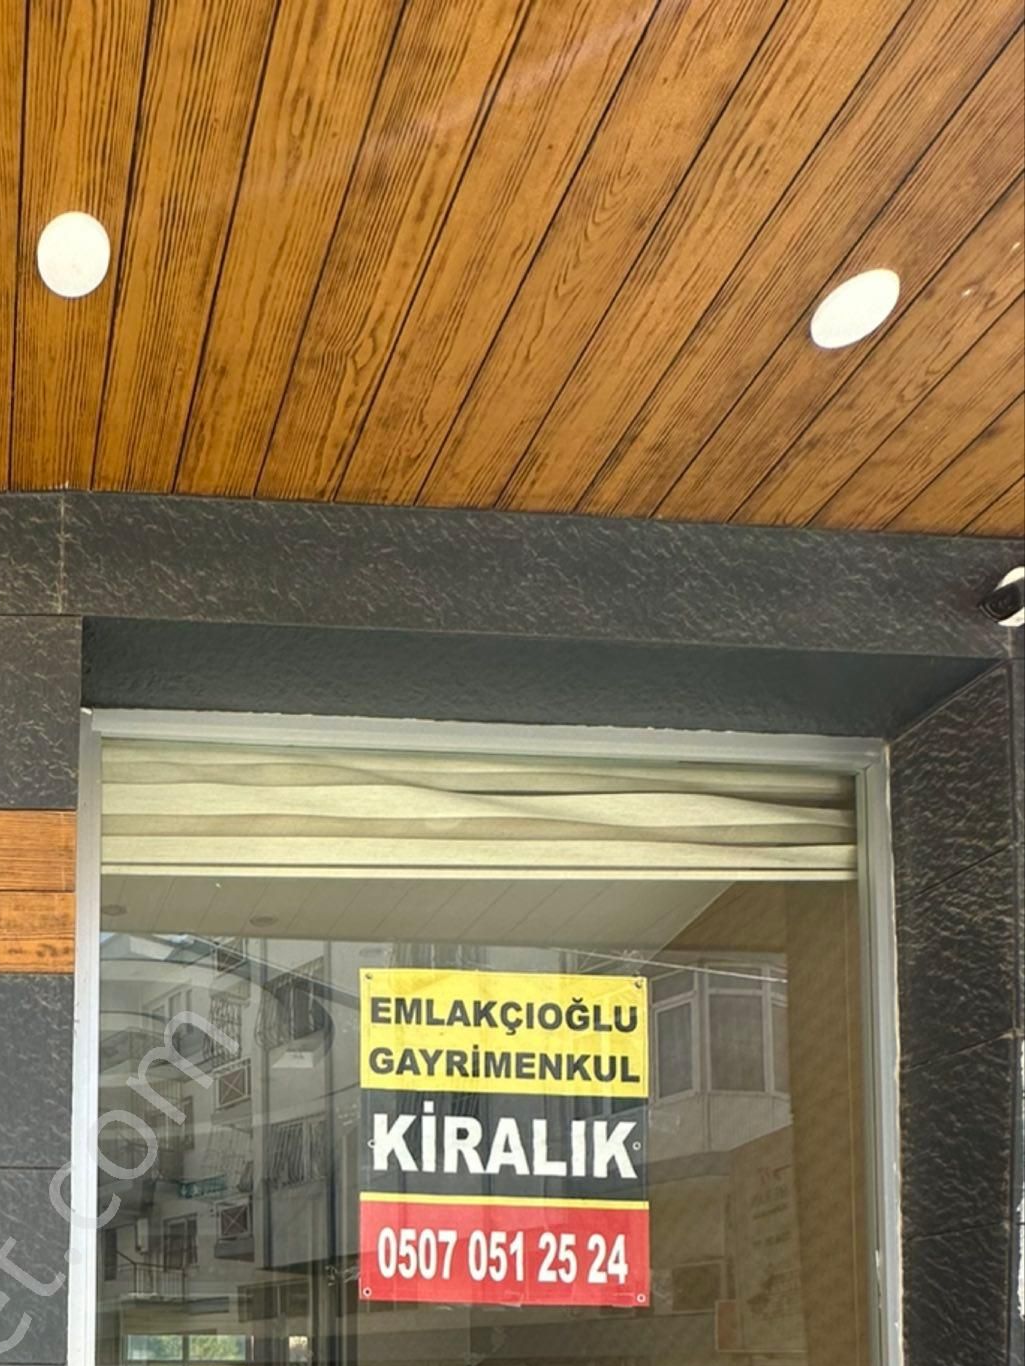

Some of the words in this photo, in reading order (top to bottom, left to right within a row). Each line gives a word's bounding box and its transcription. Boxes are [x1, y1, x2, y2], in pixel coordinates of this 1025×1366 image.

[370, 997, 639, 1036] EMLAKÇIOĞLU
[368, 1045, 641, 1084] GAYRİMENKUL
[372, 1100, 638, 1180] KİRALIK
[377, 1227, 458, 1281] 0507
[468, 1230, 525, 1283] 051
[537, 1232, 577, 1284] 25
[587, 1234, 629, 1285] 24
